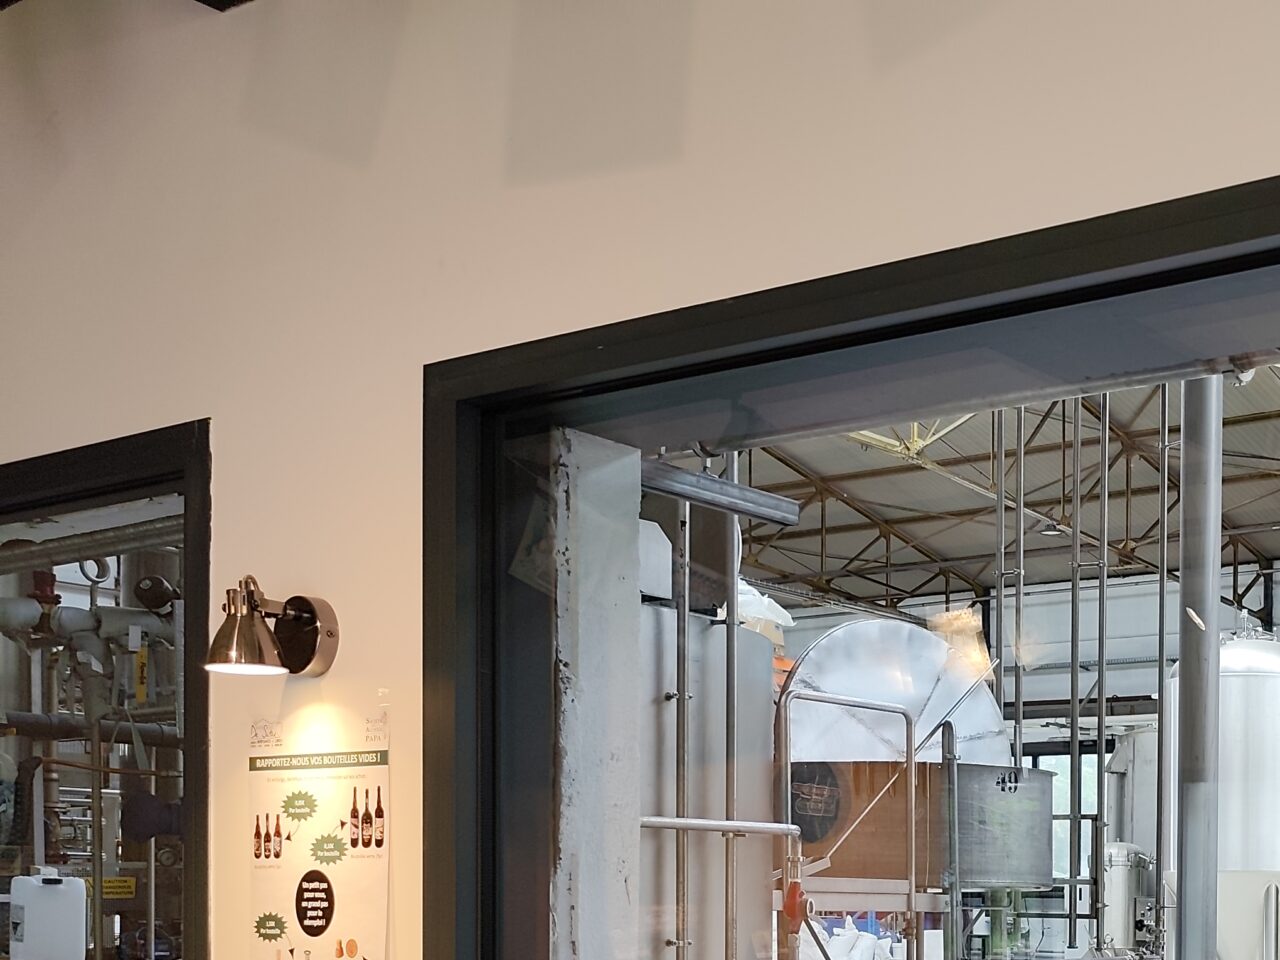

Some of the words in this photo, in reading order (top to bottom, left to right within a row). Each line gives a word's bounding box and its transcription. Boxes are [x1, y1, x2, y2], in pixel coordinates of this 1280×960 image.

[256, 757, 309, 768] RAPPORTEZ-NOUS
[311, 757, 322, 765] VOS
[323, 755, 357, 764] BOUTEILLES
[359, 754, 376, 762] VIDES
